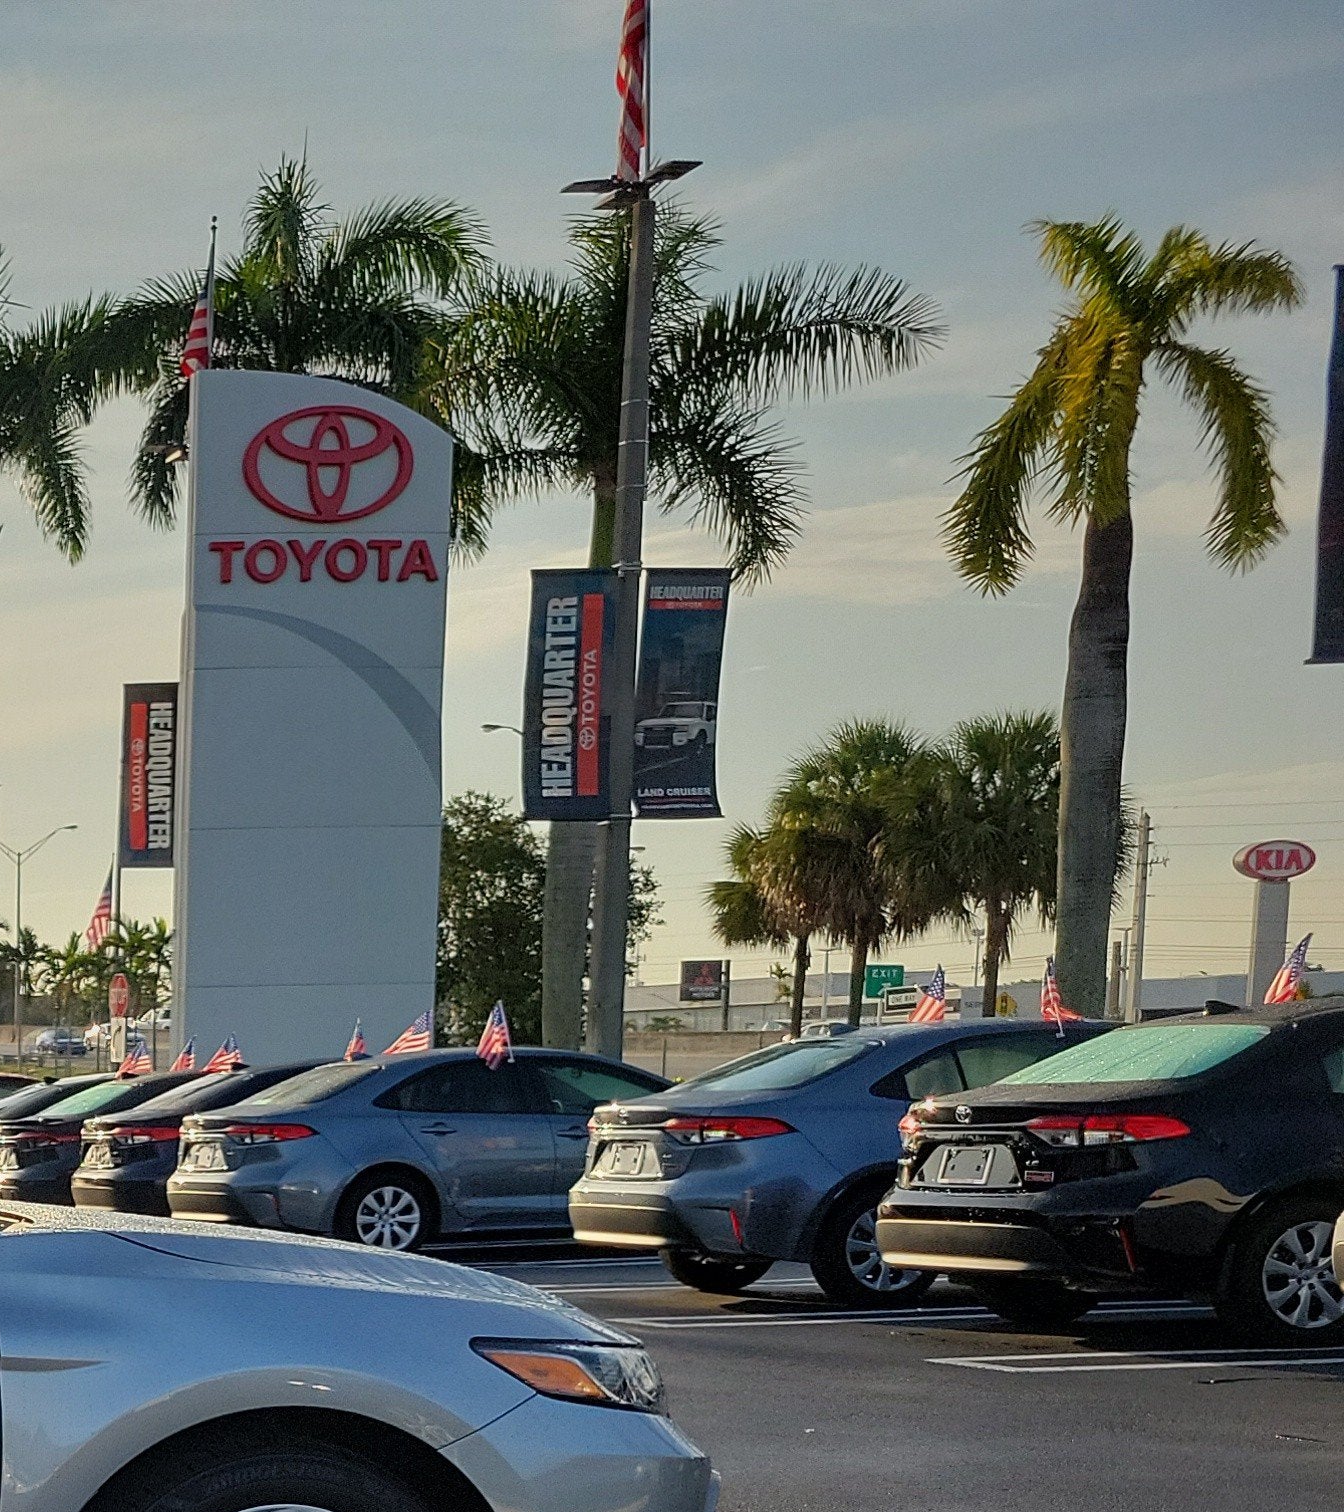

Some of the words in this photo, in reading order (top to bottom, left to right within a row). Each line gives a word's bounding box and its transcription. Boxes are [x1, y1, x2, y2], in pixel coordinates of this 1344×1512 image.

[208, 538, 439, 584] TOYOTA
[650, 586, 724, 599] HEADQUARTER
[541, 596, 578, 797] HEADQUARTER
[581, 649, 598, 726] TOYOTA
[131, 757, 144, 813] TOYOTA
[148, 701, 174, 849] HEADQUARTER
[638, 788, 664, 797] LAND
[666, 787, 711, 796] CRUISER
[1256, 849, 1304, 870] KIA
[871, 969, 898, 978] EXIT
